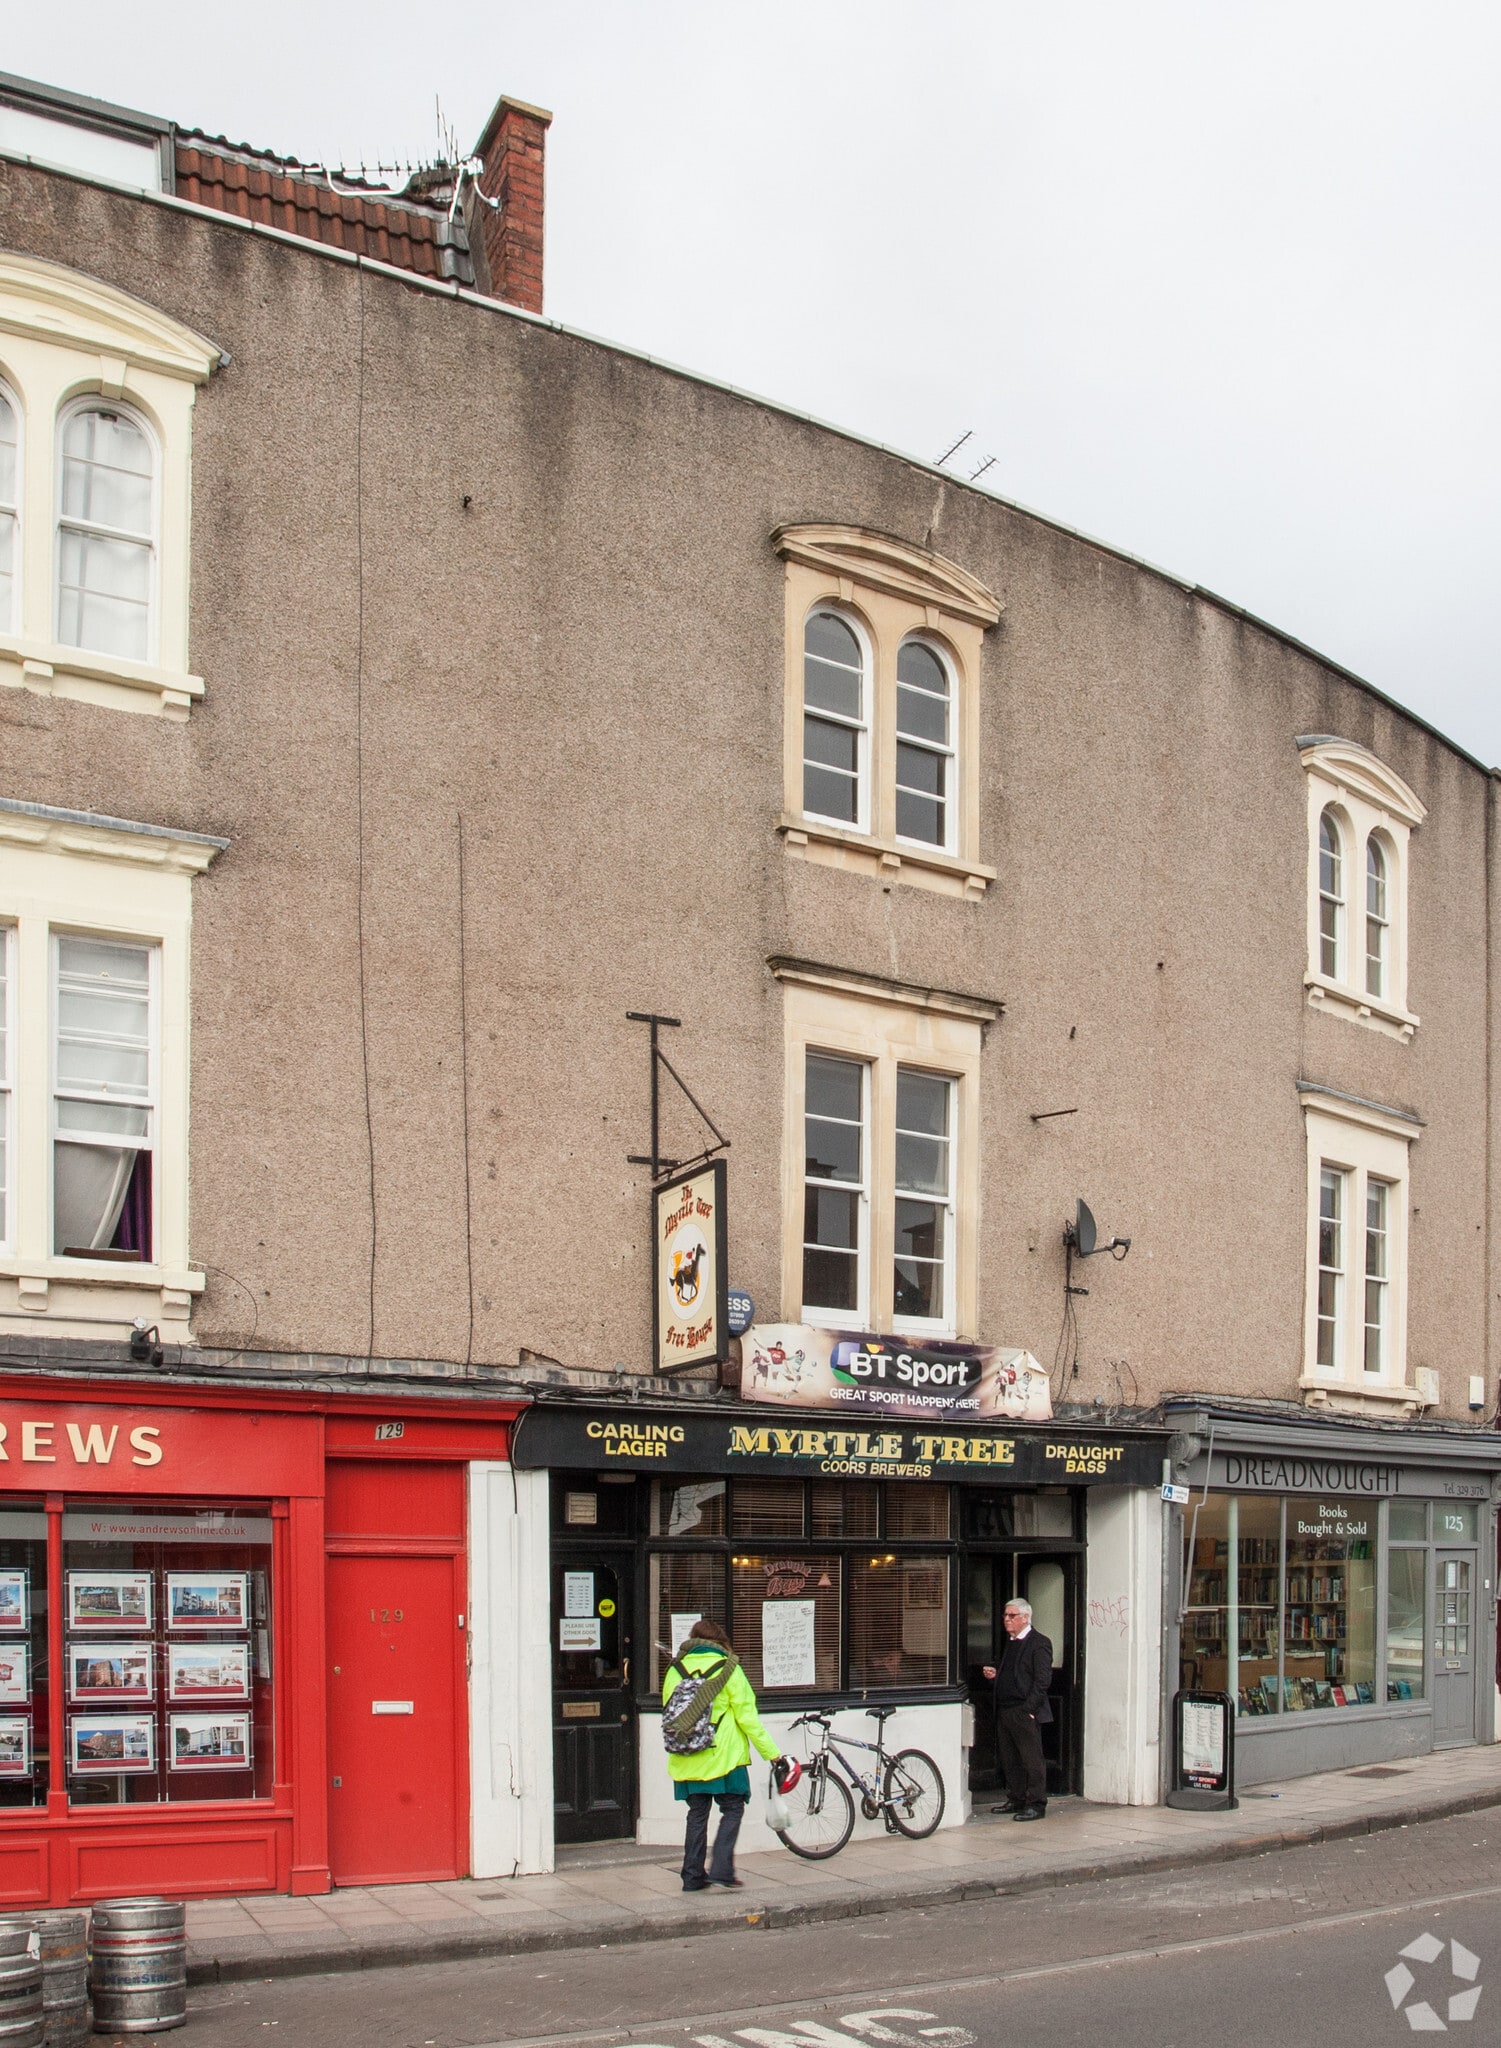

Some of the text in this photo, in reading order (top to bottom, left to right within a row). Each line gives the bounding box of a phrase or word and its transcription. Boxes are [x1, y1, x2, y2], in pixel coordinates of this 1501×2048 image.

[681, 1184, 693, 1202] The
[696, 1197, 713, 1219] Tree
[850, 1353, 969, 1388] BT Sport
[830, 1388, 980, 1410] GREAT SPORT HAPPENS HERE
[377, 1422, 404, 1439] 129
[586, 1421, 685, 1442] CARLING
[605, 1439, 667, 1457] LAGER
[728, 1426, 1015, 1467] MYRTLE TREE
[1045, 1445, 1124, 1461] DRAUGHT
[820, 1460, 931, 1478] COORS BREWERS
[1065, 1460, 1107, 1474] BASS
[1225, 1455, 1405, 1493] DREADNOUGHT
[1456, 1485, 1469, 1496] 329
[1319, 1504, 1348, 1518] Books
[109, 1524, 246, 1536] www.andrewsonline.co.uk
[1298, 1520, 1367, 1538] Bought & Sold
[1445, 1515, 1464, 1532] 125
[370, 1609, 404, 1623] 129
